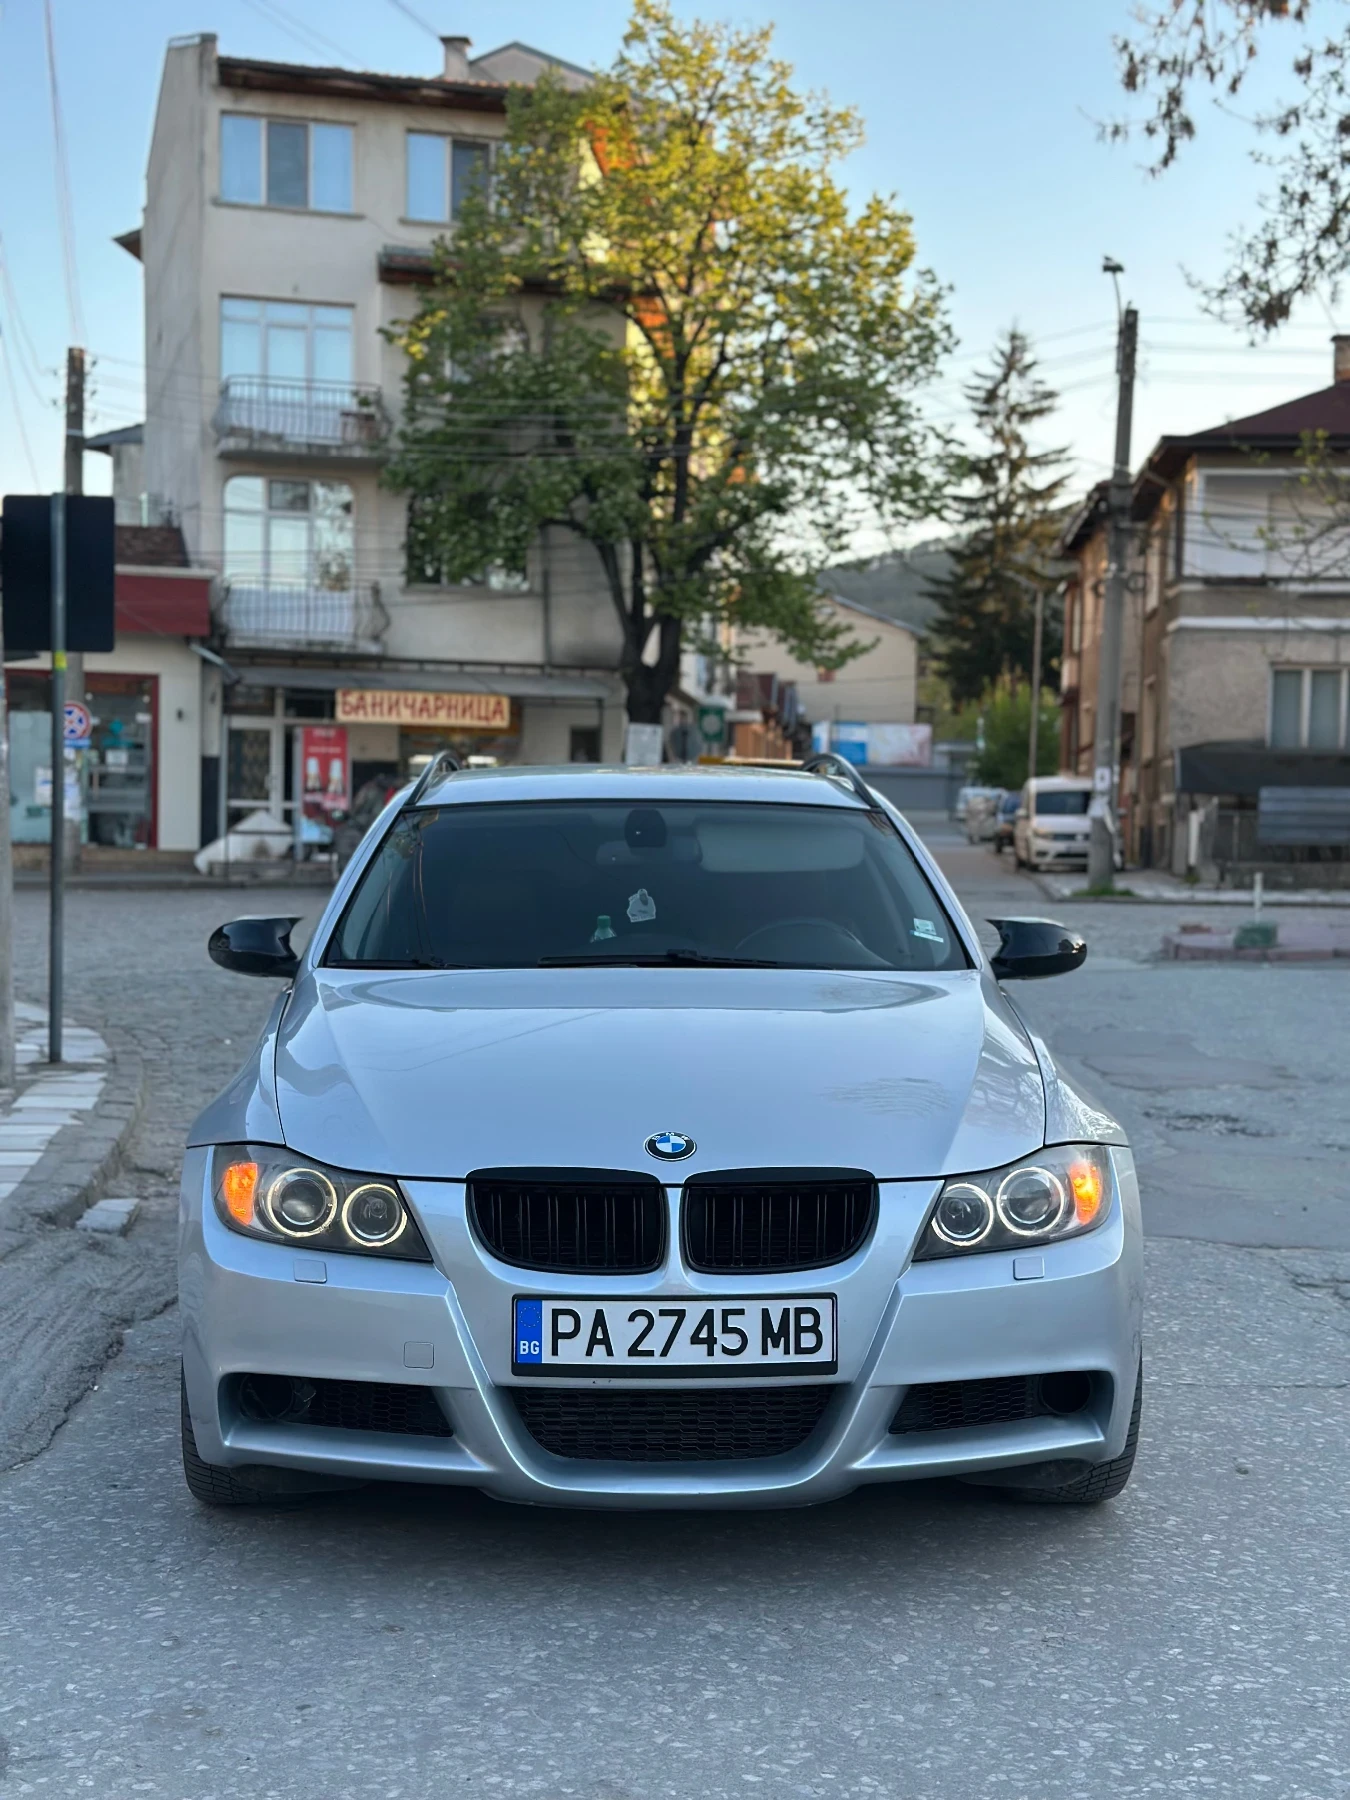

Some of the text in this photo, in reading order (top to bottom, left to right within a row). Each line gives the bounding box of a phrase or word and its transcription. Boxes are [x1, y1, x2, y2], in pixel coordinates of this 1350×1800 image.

[341, 690, 506, 724] БАНИЧАРНИЦА
[519, 1340, 540, 1355] BG
[551, 1307, 823, 1357] PA 2745 MB
